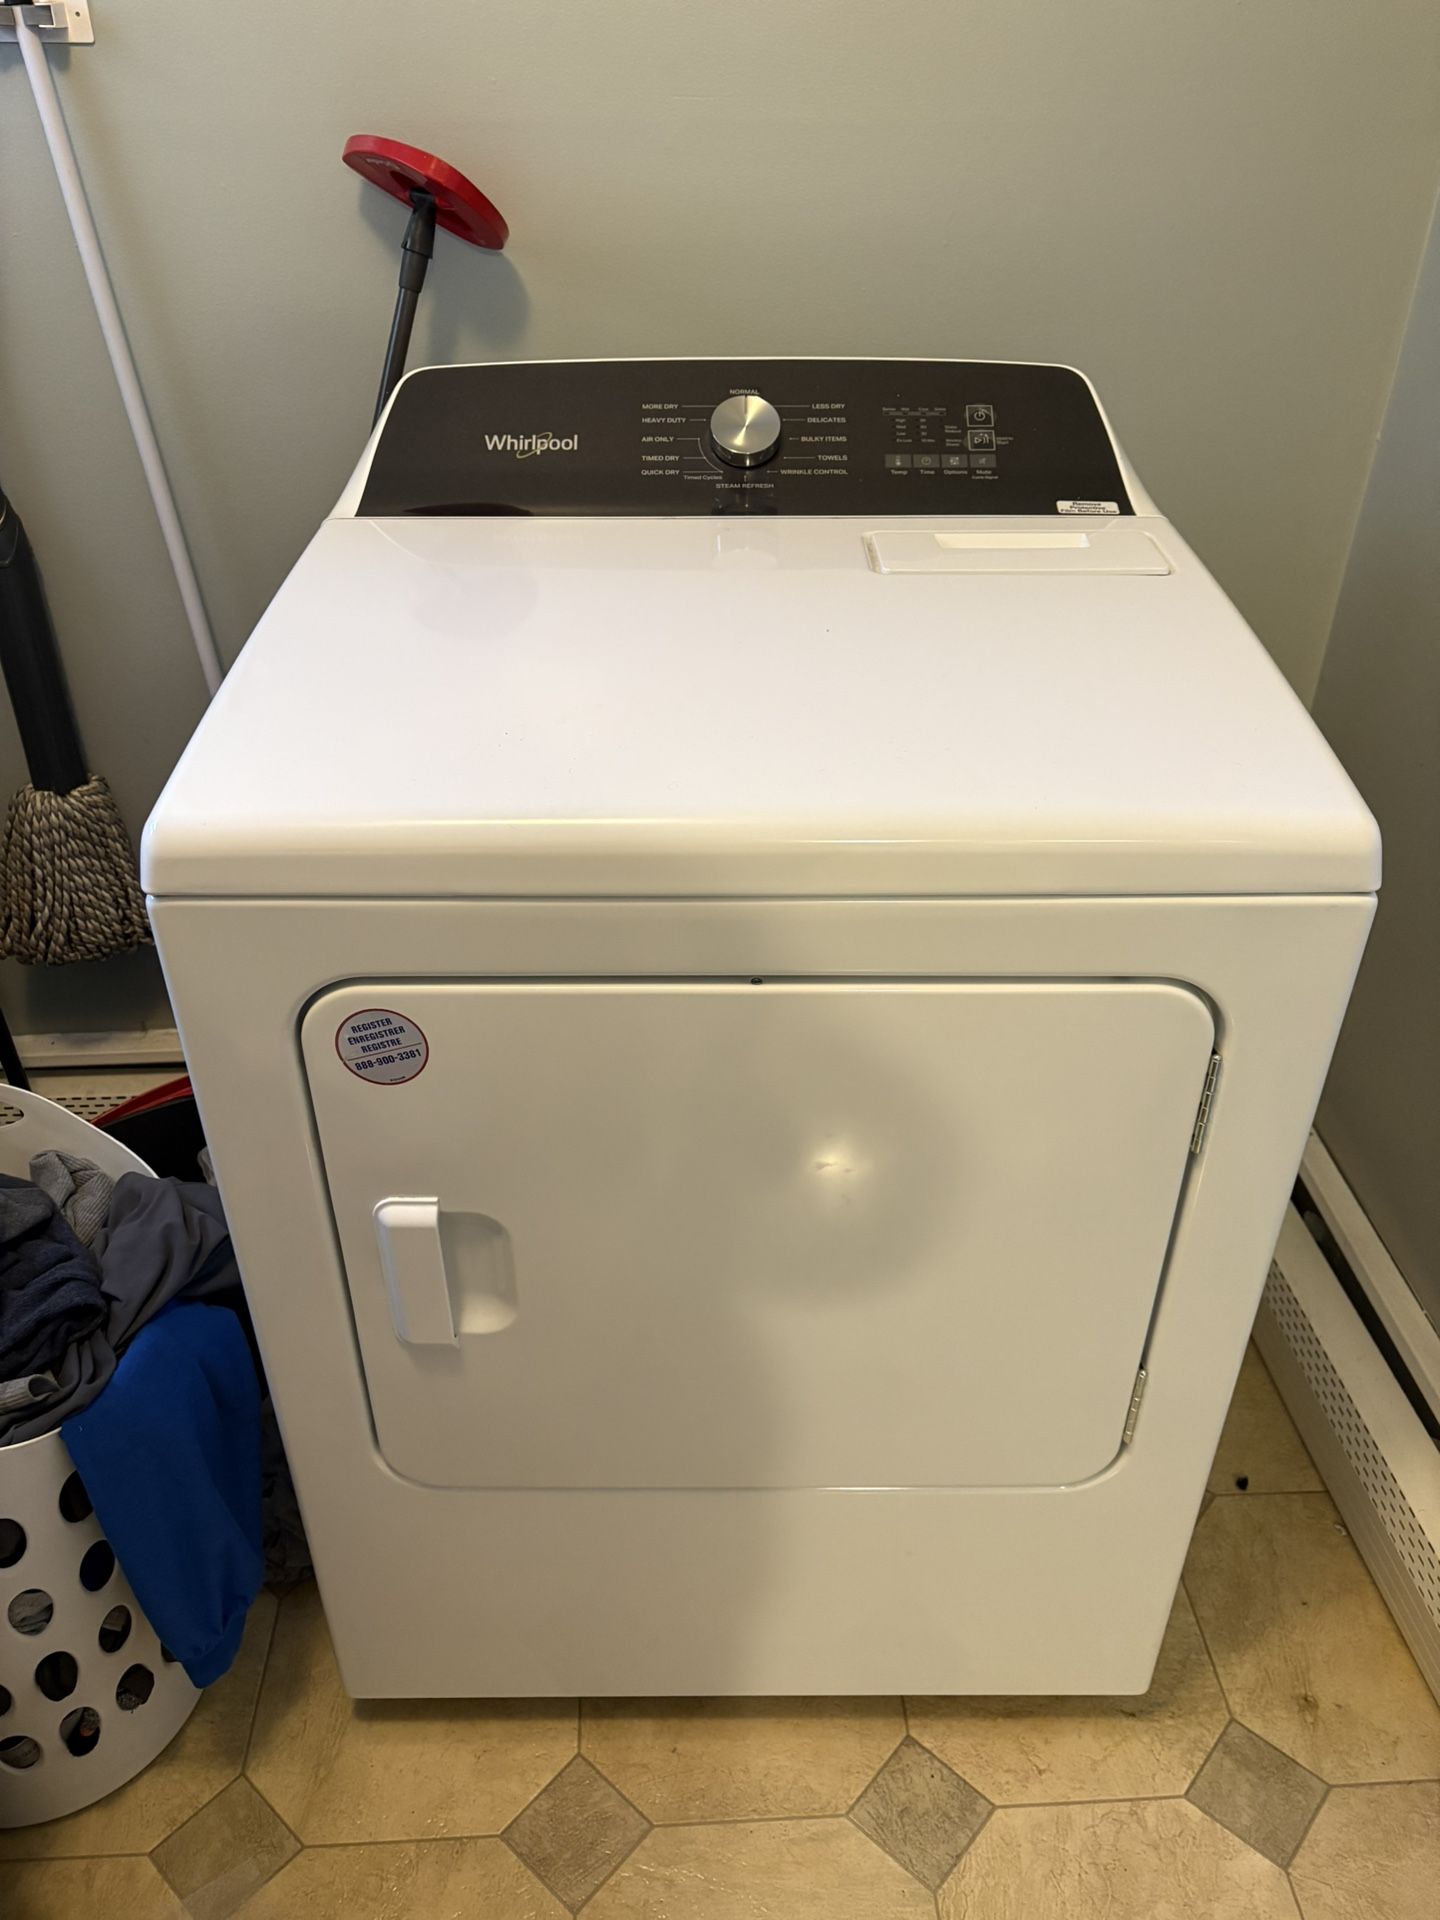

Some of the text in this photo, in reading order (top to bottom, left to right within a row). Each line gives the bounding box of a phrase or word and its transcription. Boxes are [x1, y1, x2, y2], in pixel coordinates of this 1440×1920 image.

[485, 434, 578, 455] Whirlpool
[348, 1026, 405, 1045] ENREGISTRER
[351, 1018, 392, 1034] REGISTER
[361, 1038, 402, 1053] REGISTRE
[355, 1048, 421, 1071] 888-900-3381
